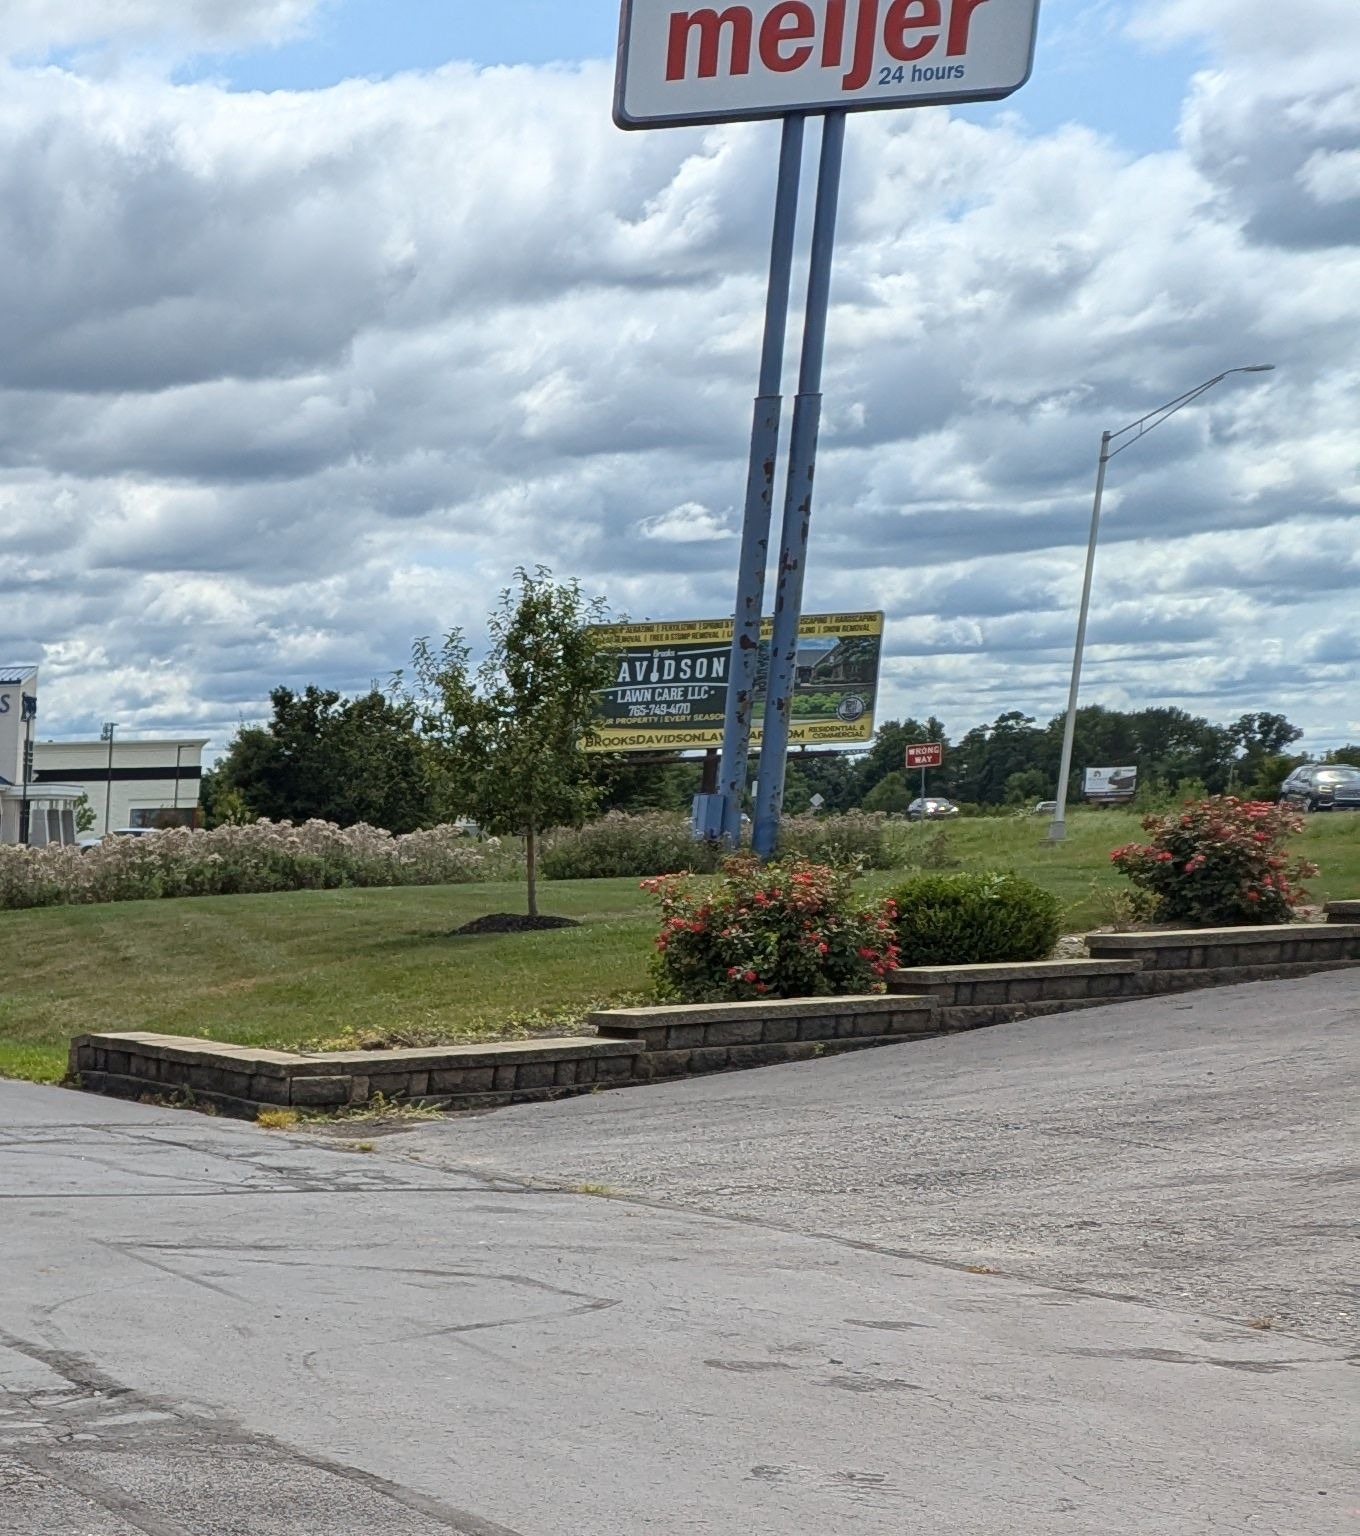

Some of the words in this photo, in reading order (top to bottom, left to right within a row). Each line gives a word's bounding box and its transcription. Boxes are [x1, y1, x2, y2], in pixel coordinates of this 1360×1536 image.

[665, 0, 988, 91] meijer
[878, 66, 904, 85] 24
[910, 63, 965, 83] hours
[617, 657, 726, 683] AVIDSON
[617, 689, 651, 703] LAWN
[654, 687, 685, 701] CARE
[687, 686, 709, 700] LLC
[615, 716, 658, 725] PROPERTY
[664, 714, 692, 723] EVERY
[808, 724, 855, 733] RESIDENTIAL
[812, 731, 864, 740] COMMERCIAL
[908, 745, 940, 756] WRONG
[914, 756, 933, 764] WAY
